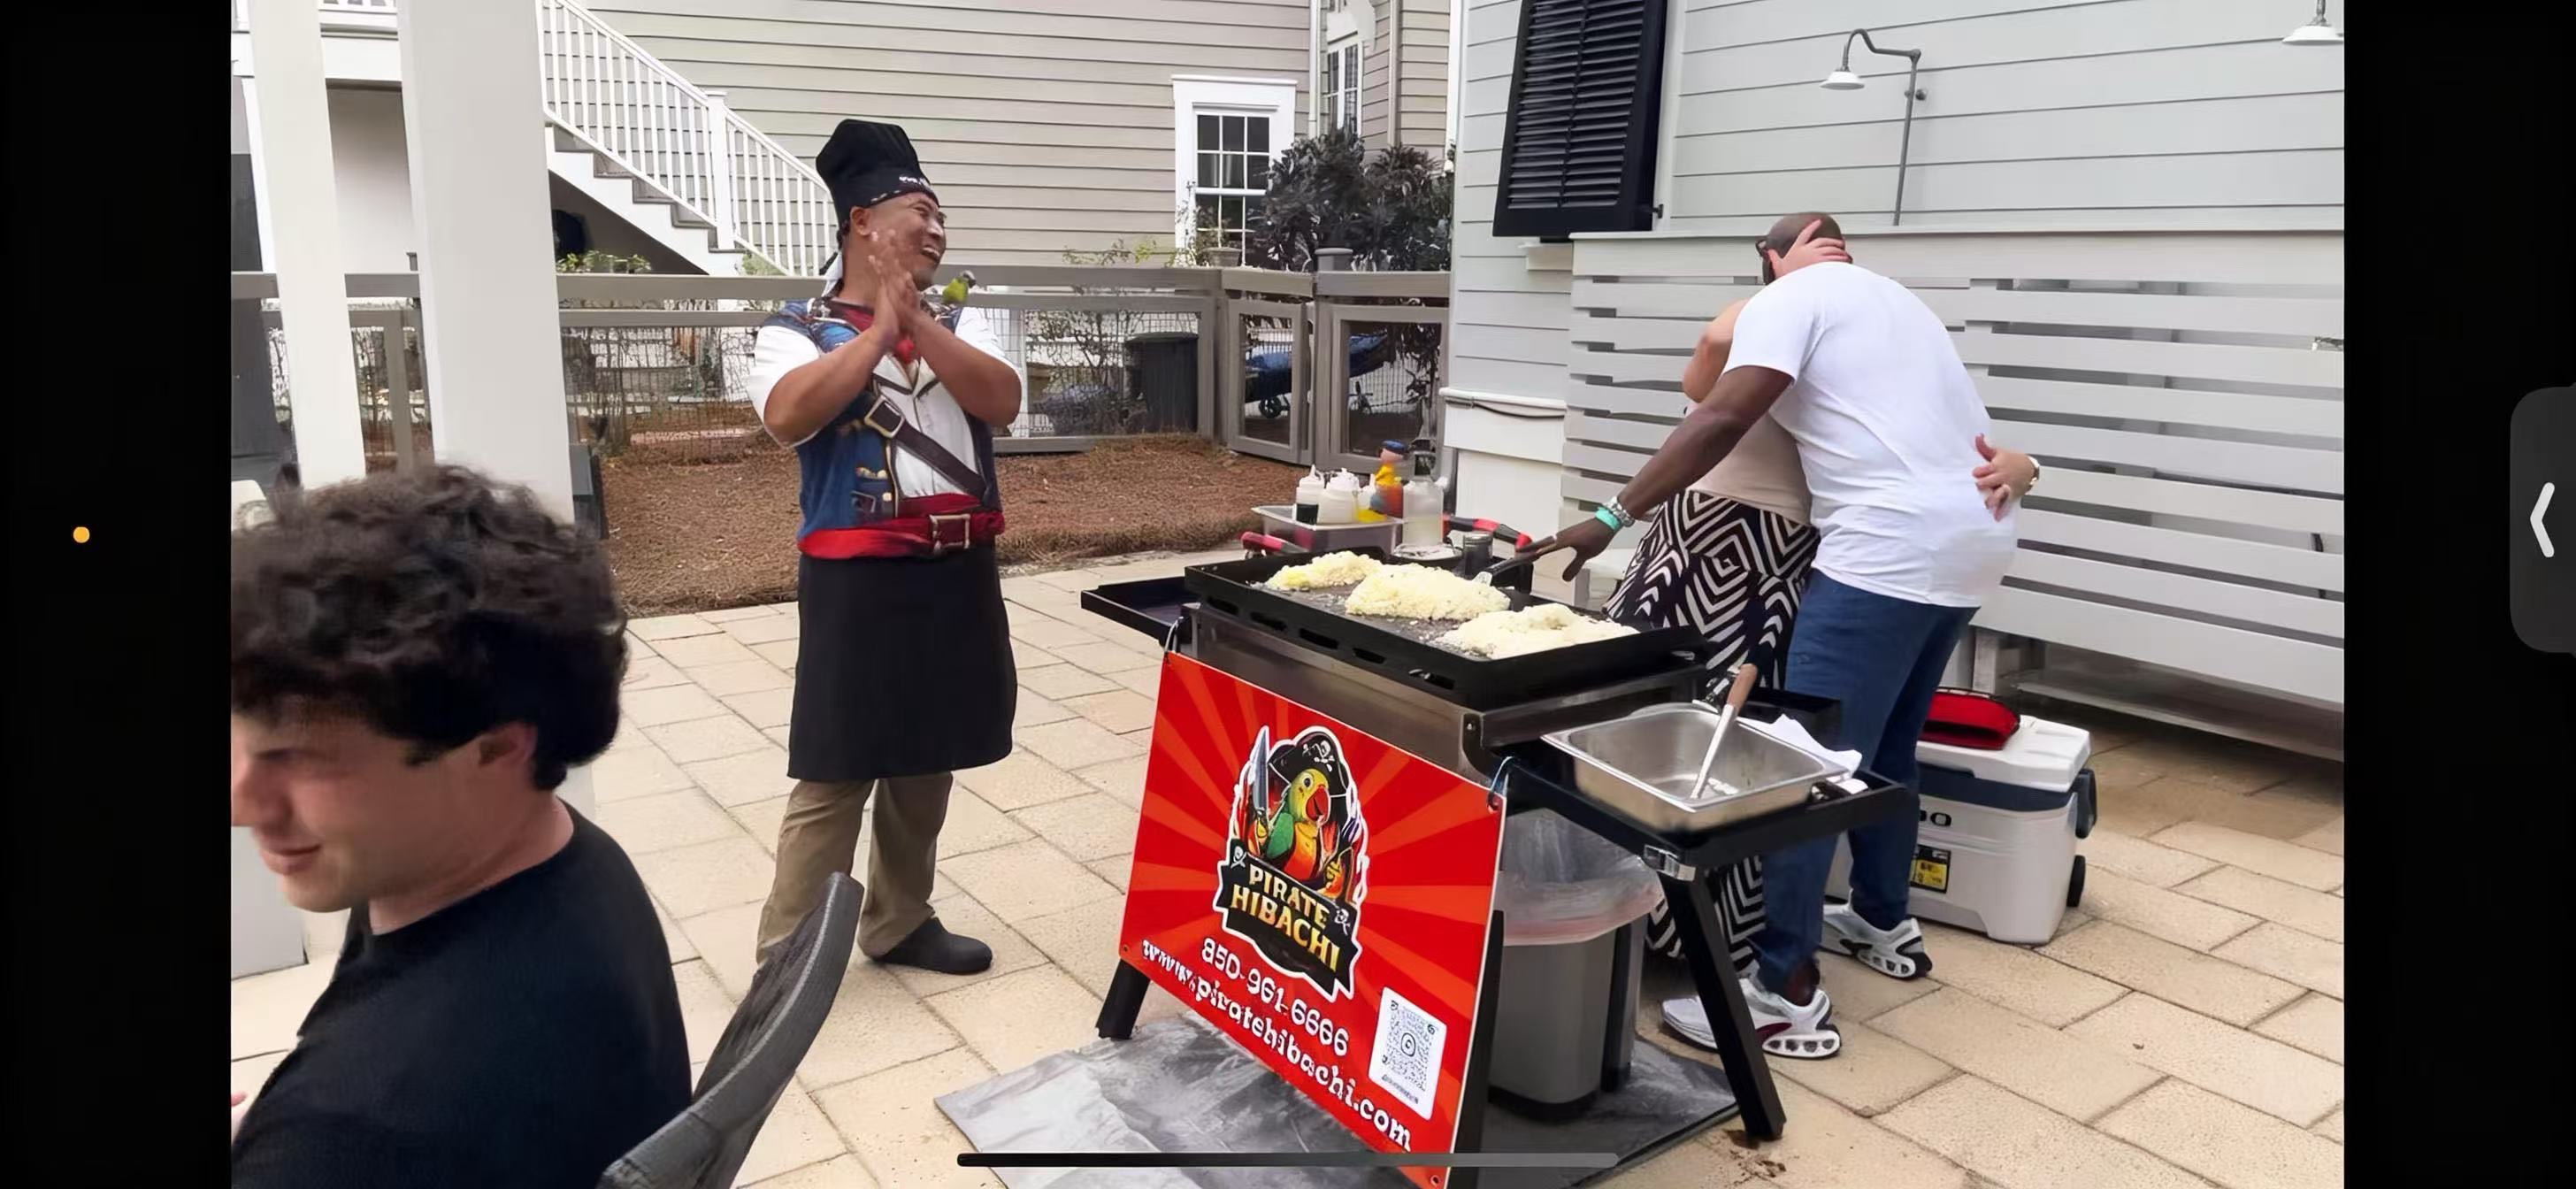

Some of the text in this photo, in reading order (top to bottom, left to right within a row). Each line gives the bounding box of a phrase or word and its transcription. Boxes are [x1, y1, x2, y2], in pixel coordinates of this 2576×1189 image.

[1230, 884, 1341, 972] HIBACHI
[1248, 863, 1330, 929] PIRATE
[1142, 939, 1412, 1153] www.piratehibachi.com
[1201, 938, 1349, 1056] 850-961-6666
